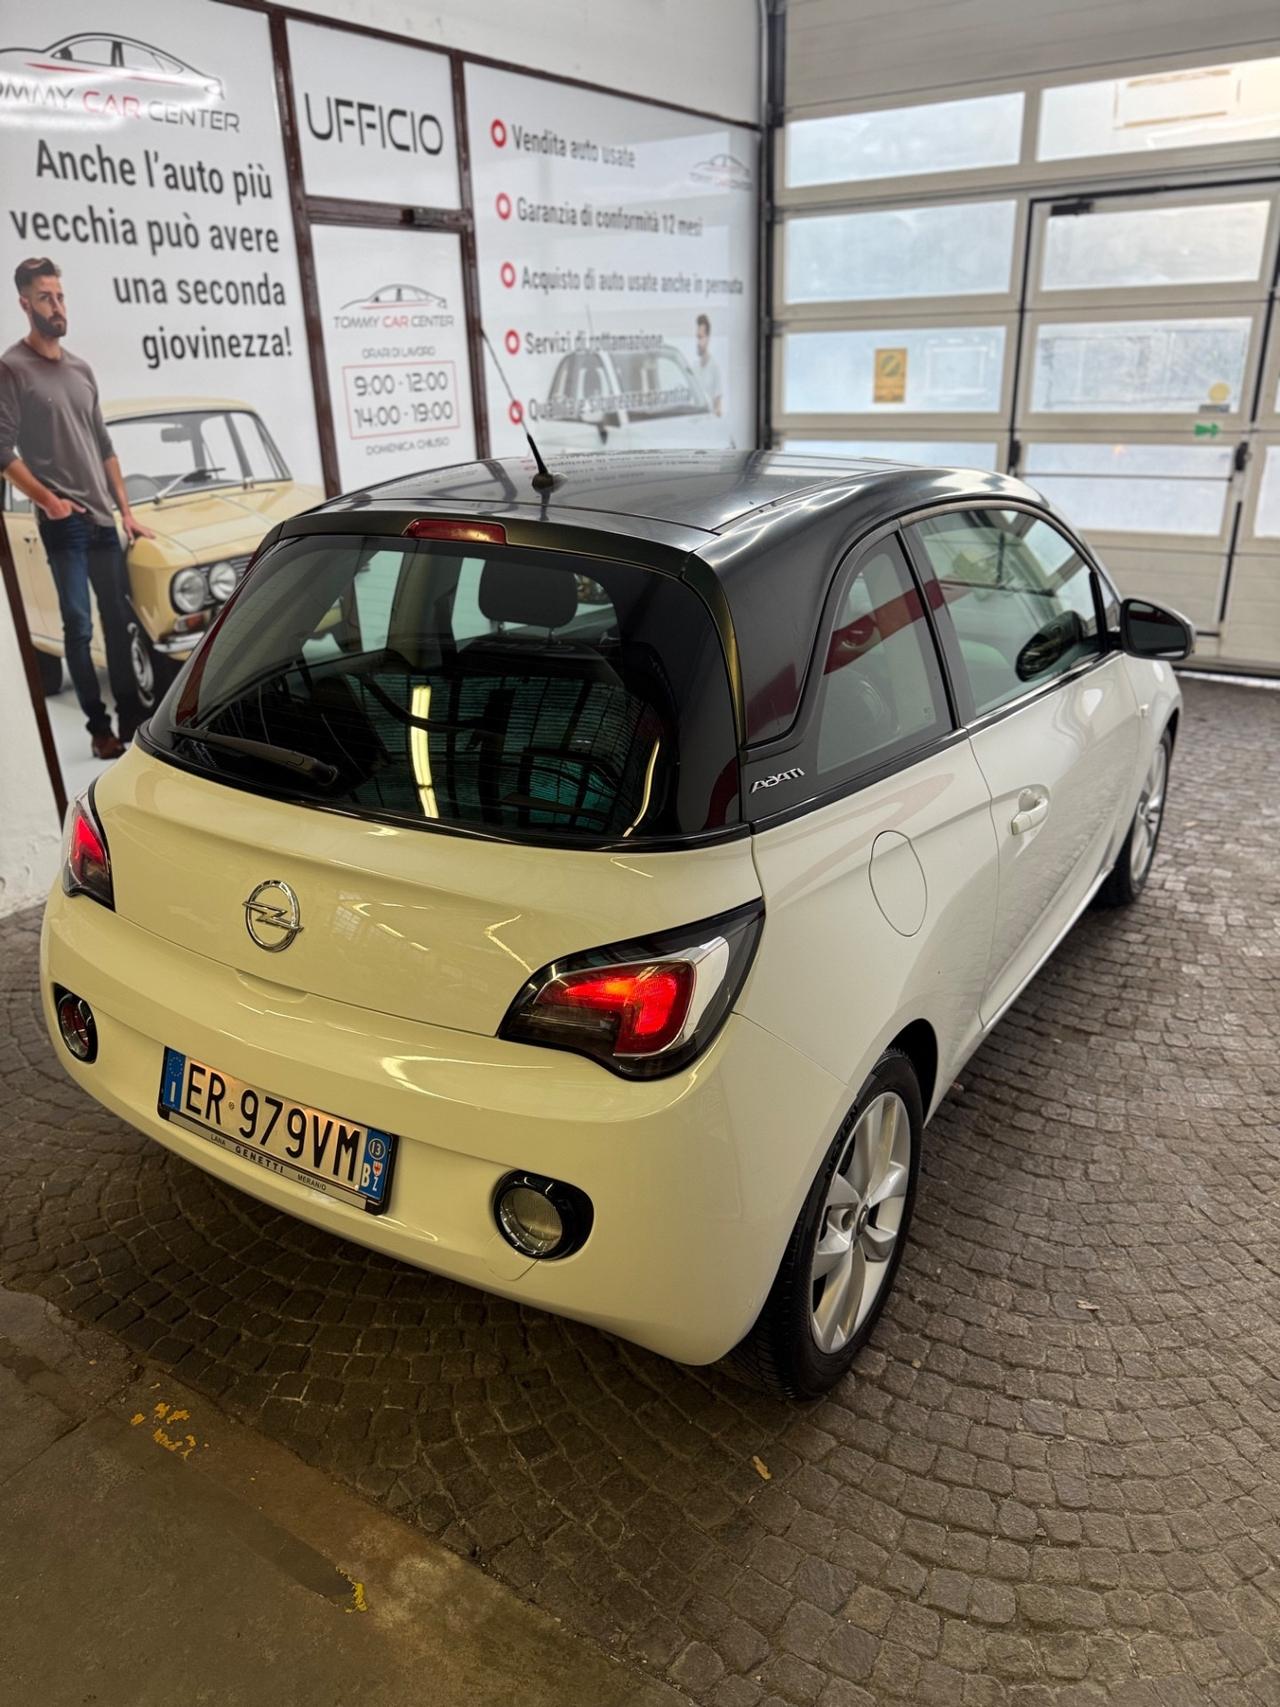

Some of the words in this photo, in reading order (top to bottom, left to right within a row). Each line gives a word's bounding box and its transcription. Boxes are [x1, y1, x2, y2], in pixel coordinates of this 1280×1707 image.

[0, 82, 75, 109] MMY
[82, 90, 141, 120] CAR
[149, 101, 241, 133] CENTER
[304, 92, 444, 156] UFFICIO
[511, 124, 567, 157] Vendita
[570, 139, 599, 162] auto
[602, 145, 636, 169] usate
[36, 139, 137, 186] Anche
[144, 150, 224, 195] l'auto
[233, 164, 273, 206] più
[9, 205, 139, 246] vecchia
[147, 211, 200, 256] può
[209, 222, 279, 253] avere
[516, 196, 578, 226] Garanzia
[580, 203, 593, 227] di
[595, 205, 659, 233] conformità
[662, 213, 675, 235] 12
[677, 216, 703, 237] mesi
[112, 275, 168, 305] una
[177, 272, 287, 307] seconda
[521, 266, 581, 295] Acquisto
[584, 268, 595, 291] di
[598, 272, 625, 292] auto
[627, 273, 658, 293] usate
[661, 272, 691, 294] anche
[333, 315, 380, 329] TOMMY
[382, 315, 410, 329] CAR
[410, 314, 455, 328] CENTER
[142, 326, 294, 370] giovinezza!
[525, 330, 572, 355] Servizi
[574, 330, 587, 352] di
[354, 373, 396, 397] 9:00
[405, 371, 449, 393] 12:00
[354, 404, 401, 429] 14:00
[410, 400, 454, 423] 19:00
[186, 1063, 227, 1126] ER
[239, 1089, 362, 1183] 979VM
[210, 1134, 226, 1146] LANA
[235, 1145, 285, 1174] GENETTI
[371, 1141, 382, 1156] 13
